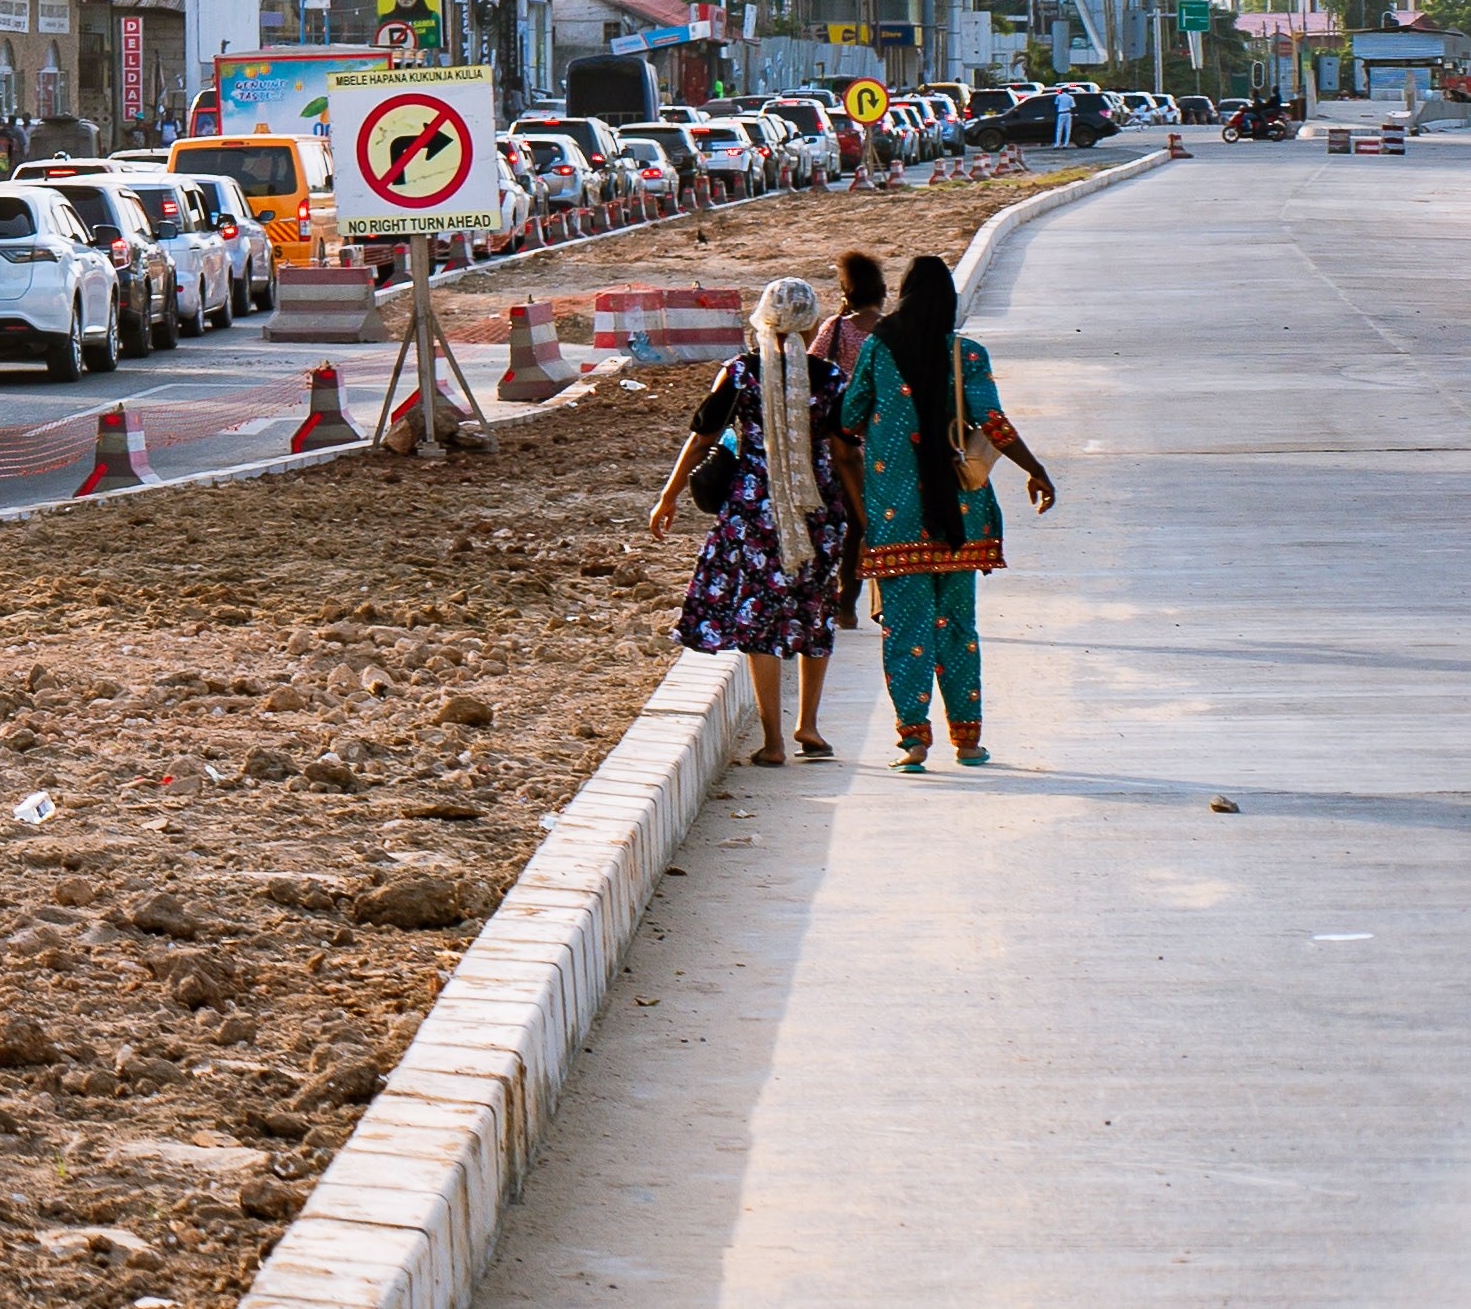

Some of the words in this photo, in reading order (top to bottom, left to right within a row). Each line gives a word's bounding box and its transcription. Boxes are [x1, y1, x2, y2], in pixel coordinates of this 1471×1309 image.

[127, 22, 137, 116] DELDAR
[336, 75, 367, 86] MBELE
[370, 73, 406, 84] HAPANA
[410, 71, 453, 82] KUKUNJA
[455, 69, 483, 80] KULIA
[349, 221, 367, 233] NO
[370, 218, 407, 232] RIGHT
[410, 217, 444, 230] TURN
[448, 215, 491, 229] AHEAD
